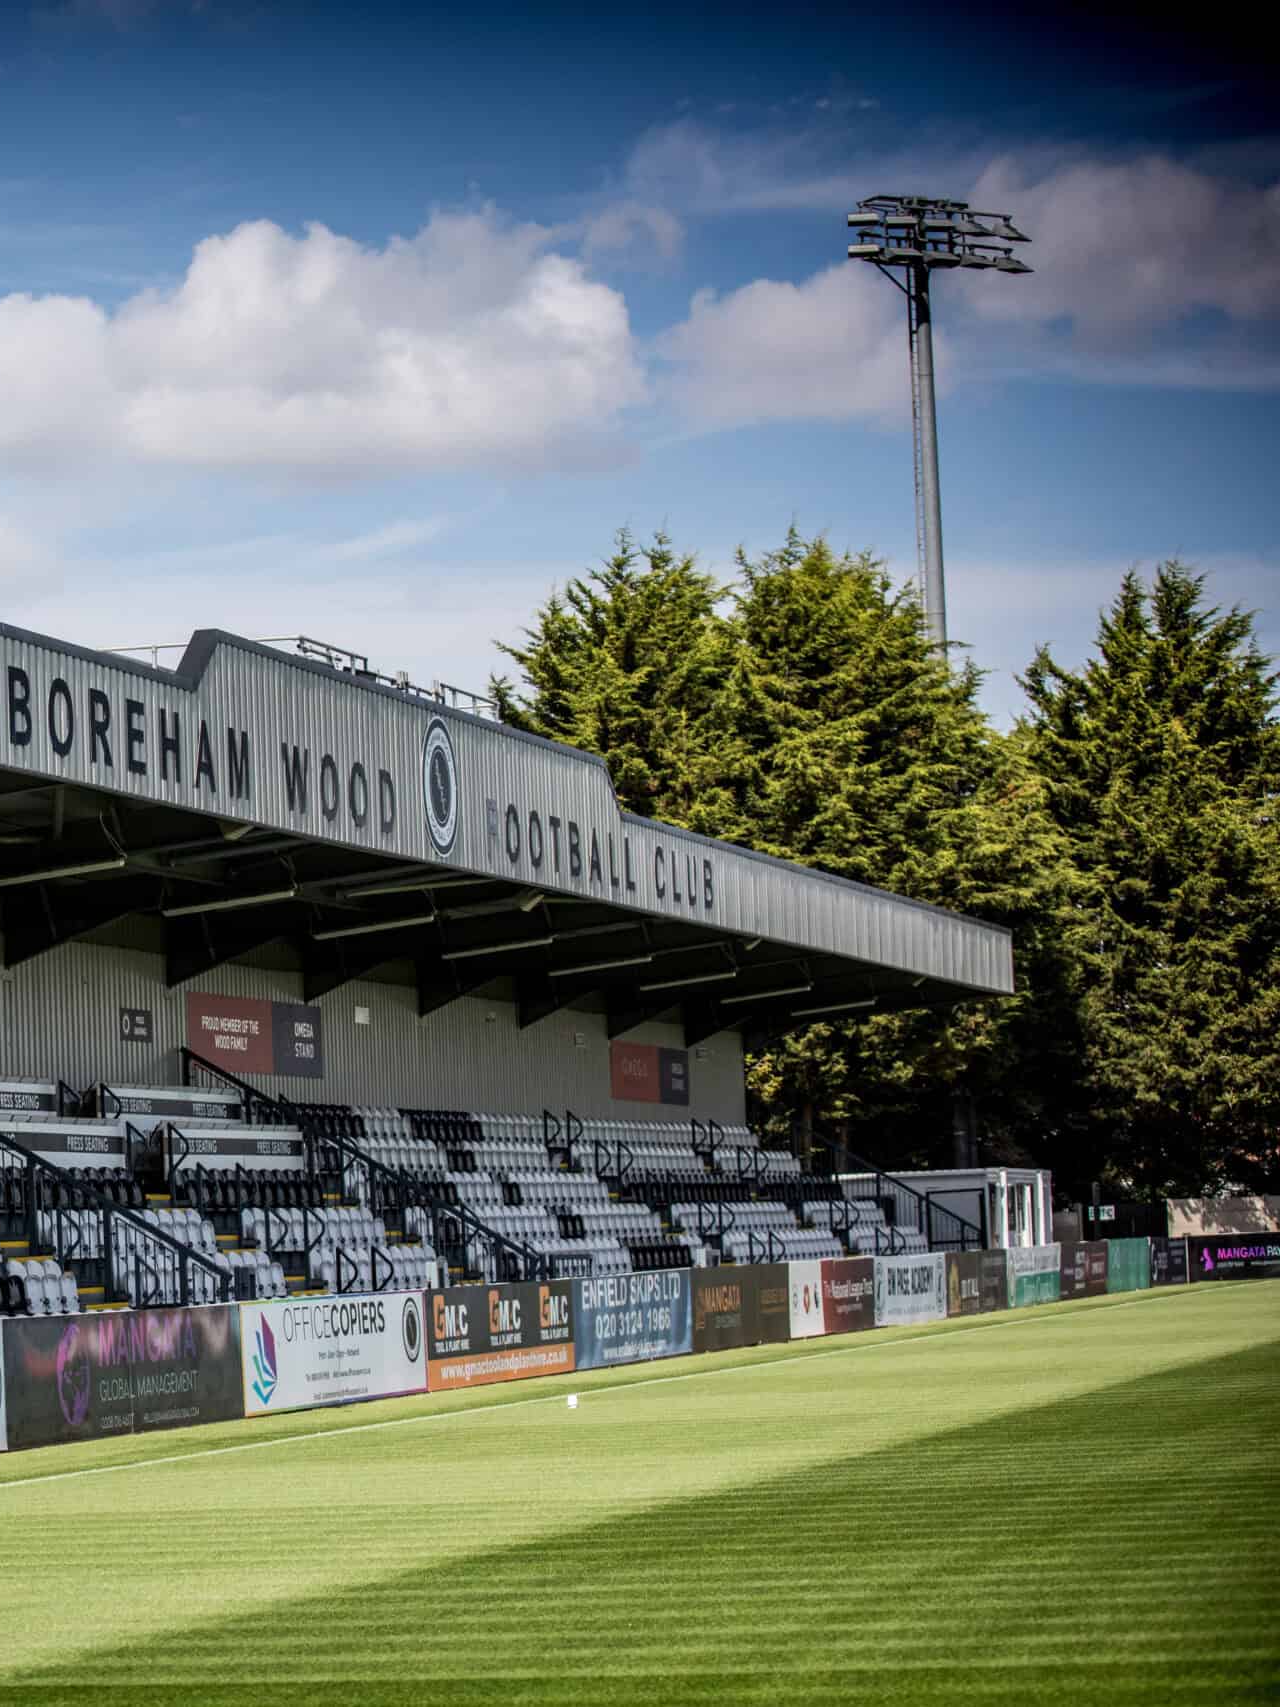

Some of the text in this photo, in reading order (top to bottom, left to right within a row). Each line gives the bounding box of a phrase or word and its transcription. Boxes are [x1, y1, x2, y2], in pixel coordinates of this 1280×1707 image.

[7, 665, 395, 834] BOREHAM WOOD
[655, 846, 714, 909] CLUB
[201, 1015, 260, 1035] PROUD MEMBER OF THE
[294, 1022, 314, 1038] OMEGA
[215, 1034, 248, 1051] WOOD FAMILY
[295, 1042, 314, 1059] STAND
[15, 1095, 39, 1109] SEATING
[67, 1135, 109, 1151] PRESS SEATING
[195, 1140, 217, 1153] SEATING
[1217, 1247, 1266, 1259] MANGATA
[581, 1271, 680, 1311] ENFIELD SKIPS LTD
[595, 1313, 616, 1339] 020
[619, 1310, 643, 1336] 3124
[100, 1369, 200, 1401] GLOBAL MANAGEMENT
